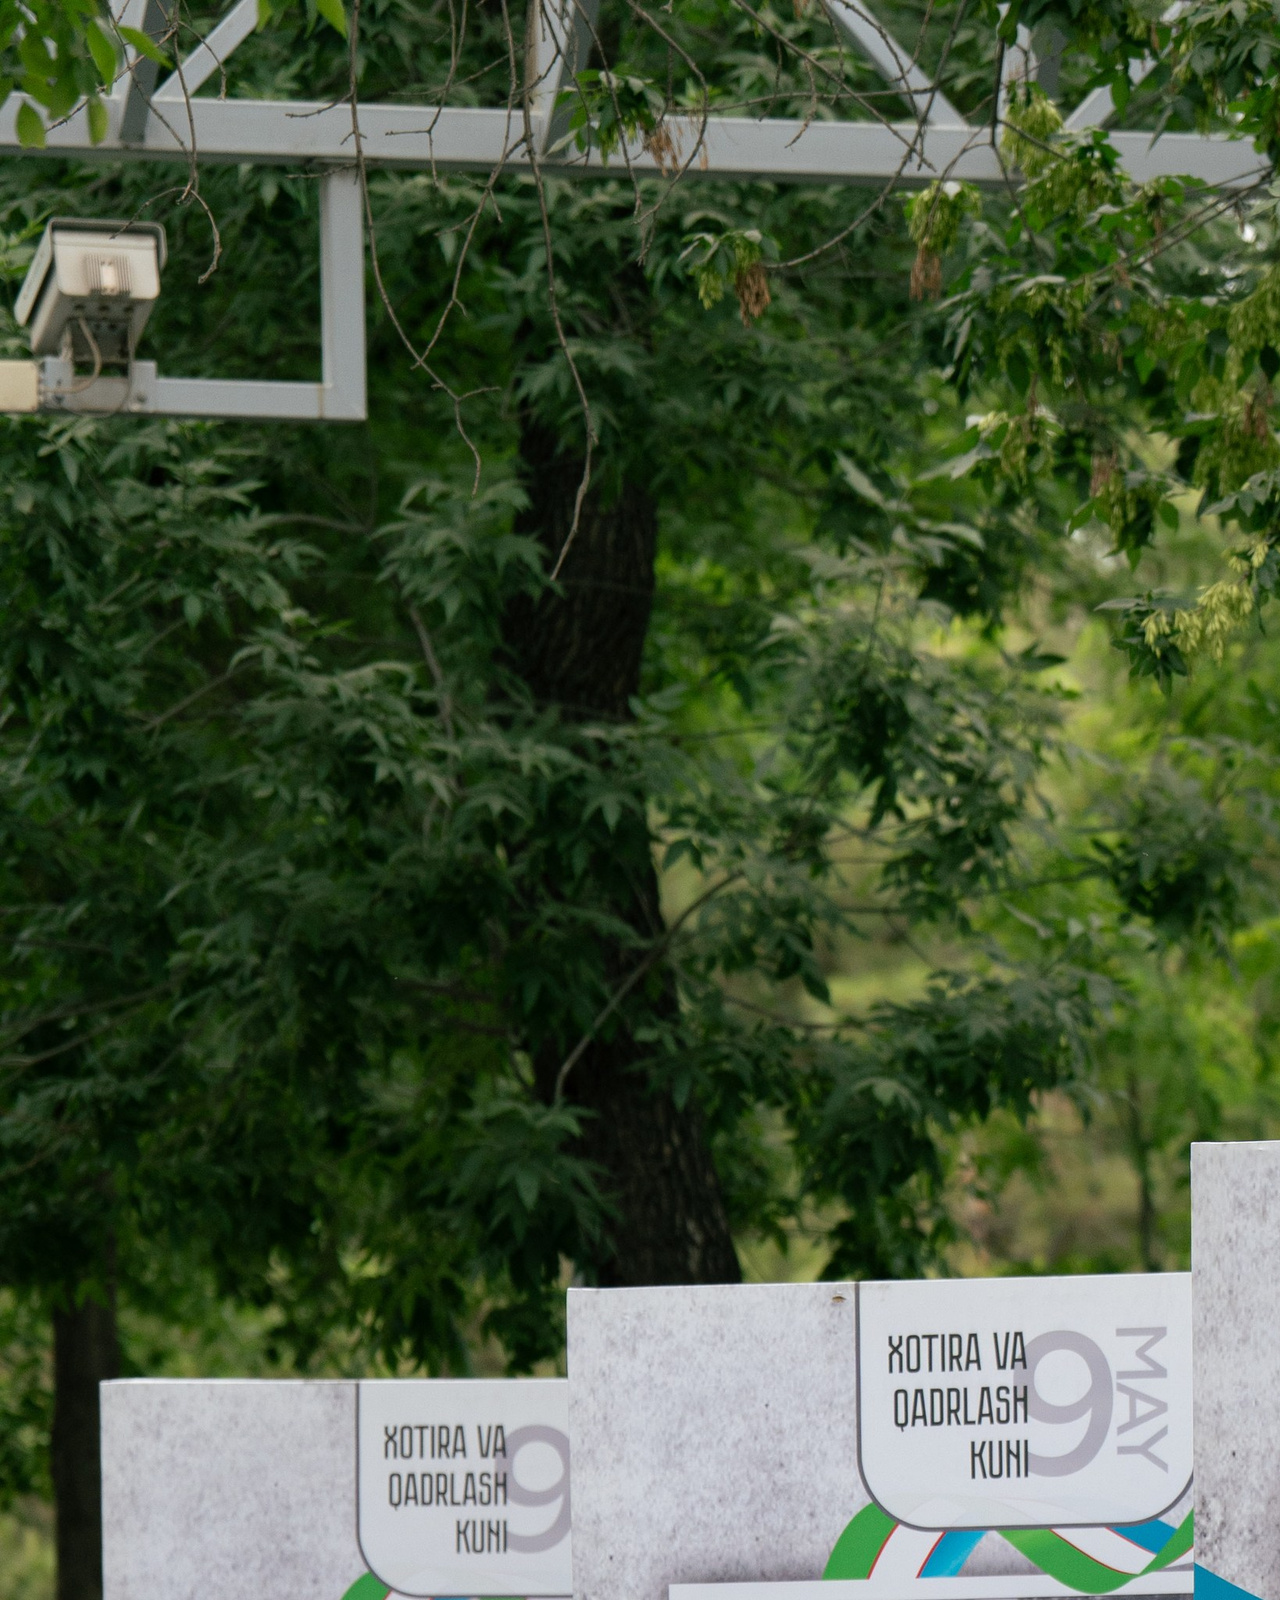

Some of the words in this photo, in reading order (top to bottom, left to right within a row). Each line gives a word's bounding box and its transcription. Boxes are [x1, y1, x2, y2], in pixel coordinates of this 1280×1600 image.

[888, 1333, 982, 1374] XOTIRA
[993, 1331, 1028, 1370] VA
[893, 1385, 1028, 1432] QADRLASH
[1013, 1330, 1114, 1477] 9
[1115, 1326, 1169, 1474] MAY
[384, 1424, 467, 1460] XOTIRA
[477, 1424, 507, 1459] VA
[970, 1439, 1029, 1480] KUNI
[388, 1472, 508, 1511] QADRLASH
[494, 1424, 572, 1554] 9
[455, 1520, 508, 1554] KUNI
